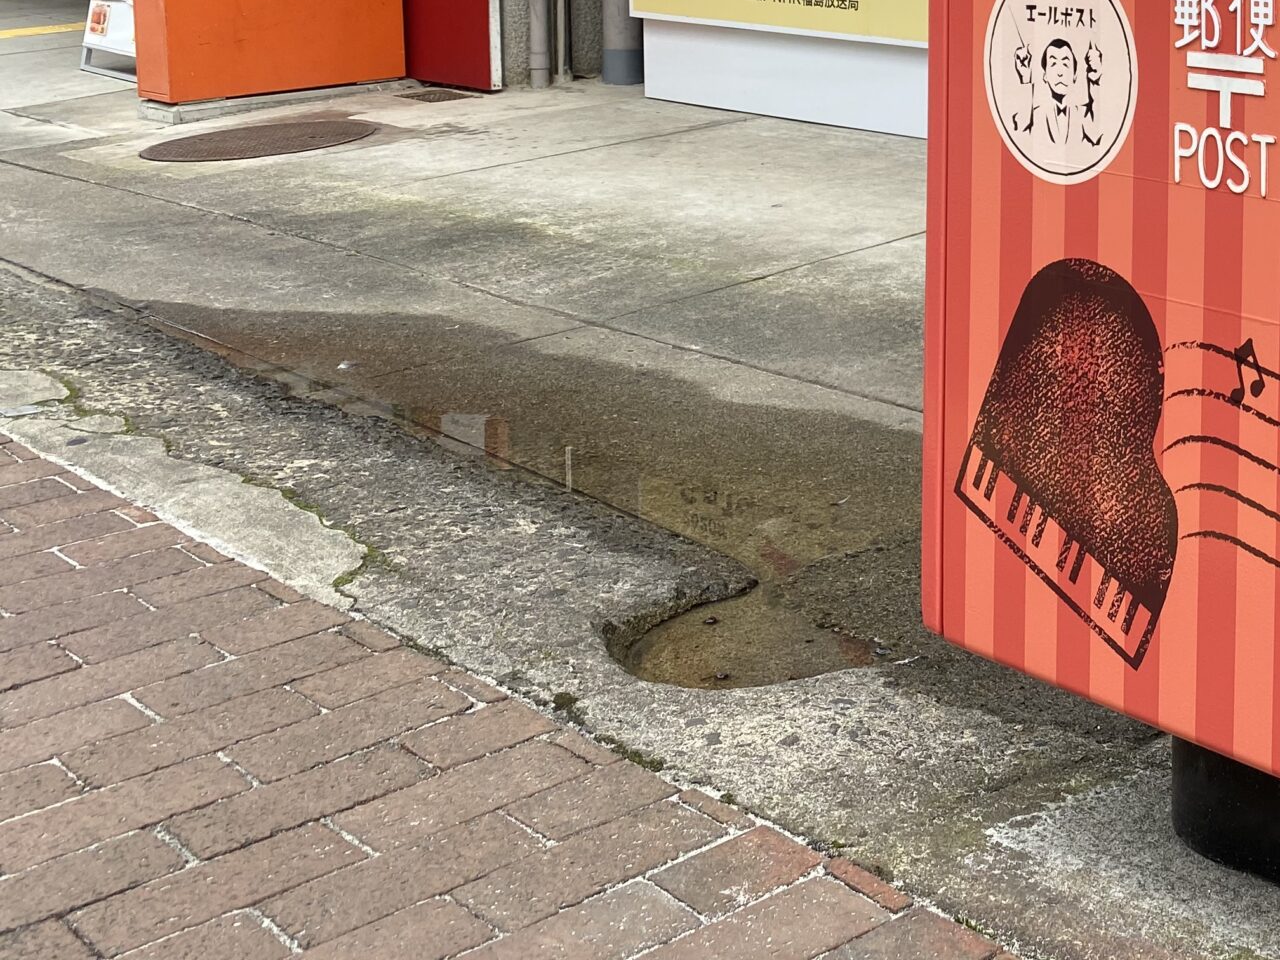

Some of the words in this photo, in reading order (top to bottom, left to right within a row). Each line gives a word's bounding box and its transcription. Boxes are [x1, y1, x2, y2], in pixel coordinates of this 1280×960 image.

[1025, 3, 1097, 29] エールポスト
[1173, 121, 1278, 199] POST
